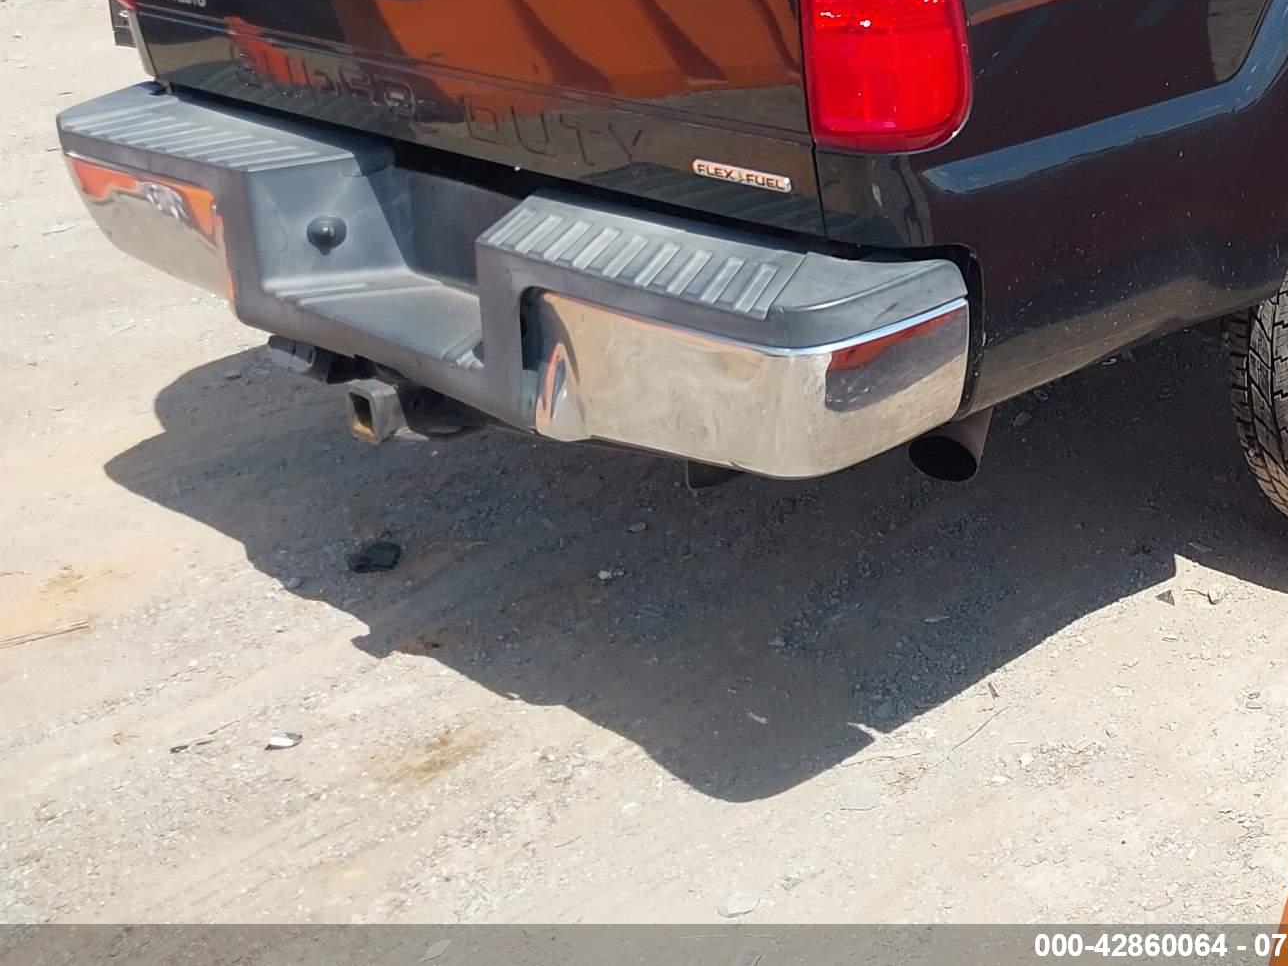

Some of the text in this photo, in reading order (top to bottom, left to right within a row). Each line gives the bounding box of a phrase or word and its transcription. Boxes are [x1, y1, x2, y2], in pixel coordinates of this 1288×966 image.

[458, 93, 646, 167] DUTY
[697, 164, 785, 190] FLEX FUEL
